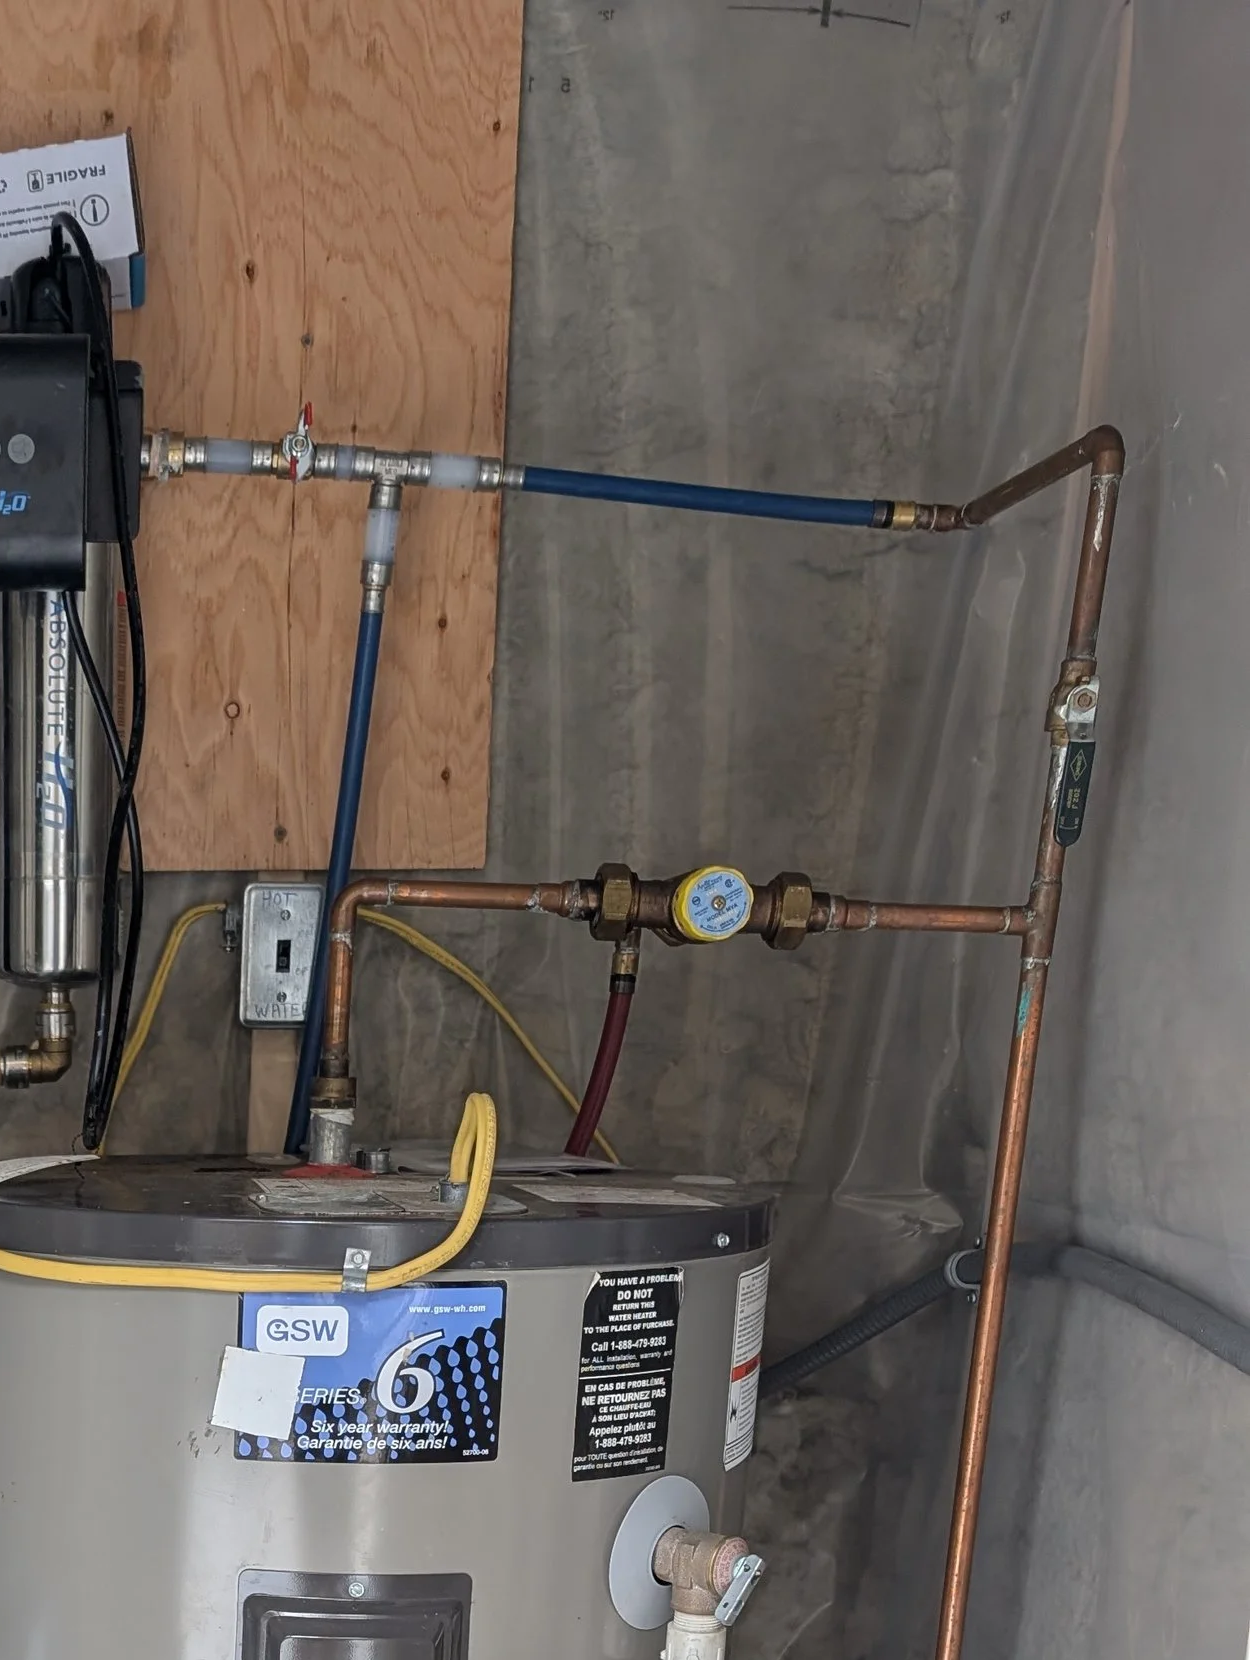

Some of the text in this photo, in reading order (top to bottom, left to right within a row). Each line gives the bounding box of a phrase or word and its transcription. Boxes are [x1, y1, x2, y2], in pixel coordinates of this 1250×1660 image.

[45, 163, 106, 185] FRAGILE
[46, 599, 68, 737] ABSOLUTE
[706, 909, 726, 923] MODEL
[598, 1278, 615, 1287] YOU
[616, 1276, 638, 1286] HAVE
[638, 1276, 645, 1284] A
[616, 1287, 654, 1300] DO NOT
[408, 1301, 486, 1316] www.gsw-wh.com
[612, 1300, 655, 1311] RETURN THIS
[607, 1310, 657, 1322] WATER HEATER
[265, 1317, 338, 1343] GSW
[583, 1326, 594, 1334] TO
[595, 1325, 609, 1333] THE
[610, 1323, 631, 1332] PLACE
[642, 1319, 674, 1329] PURCHASE.
[590, 1335, 667, 1352] Call 1-888-479-9283
[580, 1356, 590, 1364] for
[591, 1355, 604, 1363] ALL
[663, 1348, 672, 1356] and
[295, 1326, 445, 1415] ERIES 6
[584, 1384, 597, 1392] EN
[597, 1382, 614, 1391] CAS
[615, 1381, 626, 1390] DE
[581, 1388, 666, 1406] NE RETOURNEZ PAS
[598, 1400, 651, 1413] CE CHAUFFE-EAU
[597, 1414, 612, 1422] SON
[613, 1412, 628, 1420] LIEU
[310, 1418, 449, 1438] Six year warranty!
[588, 1421, 656, 1437] Appelez plutôt au
[296, 1435, 447, 1451] Garantie de six ans!
[594, 1432, 652, 1448] 1-888-479-9283
[573, 1455, 587, 1463] pour
[587, 1452, 607, 1461] TOUTE
